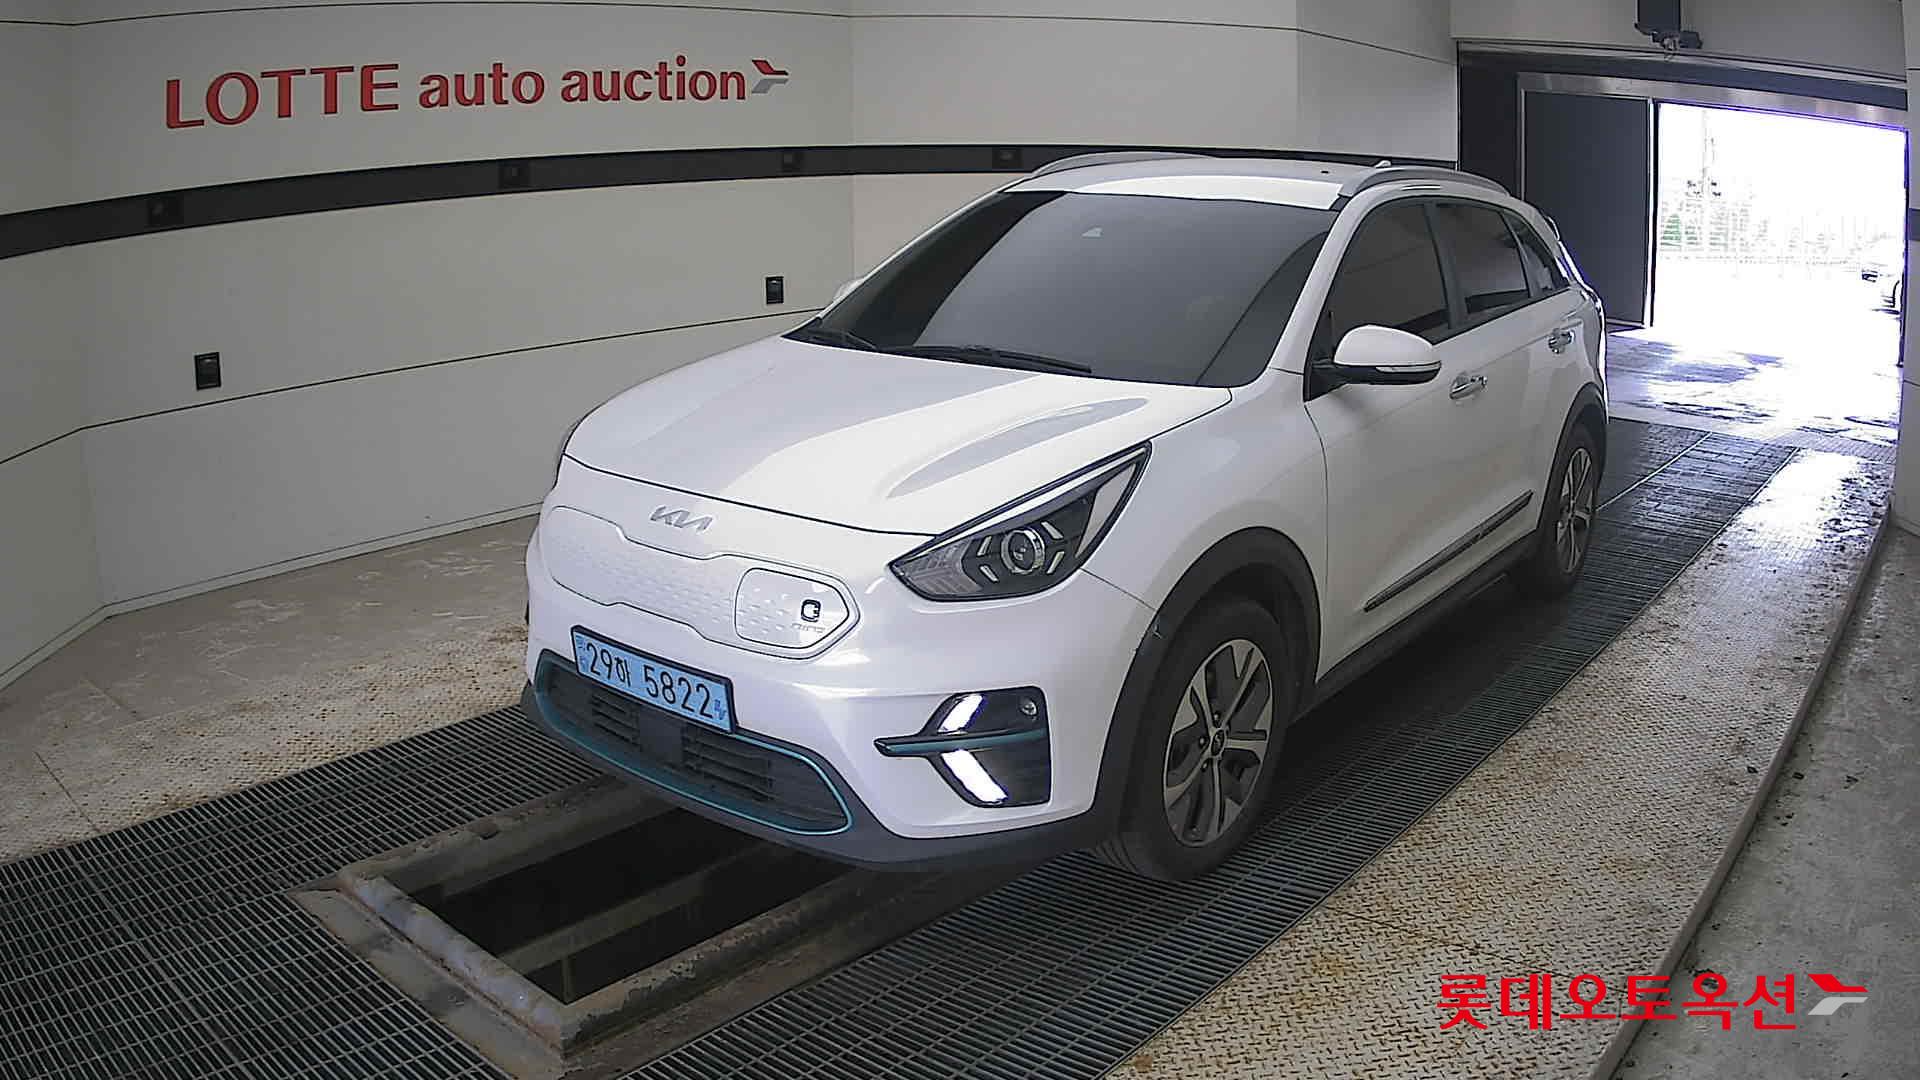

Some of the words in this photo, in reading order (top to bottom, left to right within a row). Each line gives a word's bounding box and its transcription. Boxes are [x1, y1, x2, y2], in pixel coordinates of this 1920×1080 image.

[166, 63, 399, 129] LOTTE
[419, 62, 545, 109] auto
[561, 56, 746, 104] auction
[643, 664, 713, 718] 5822
